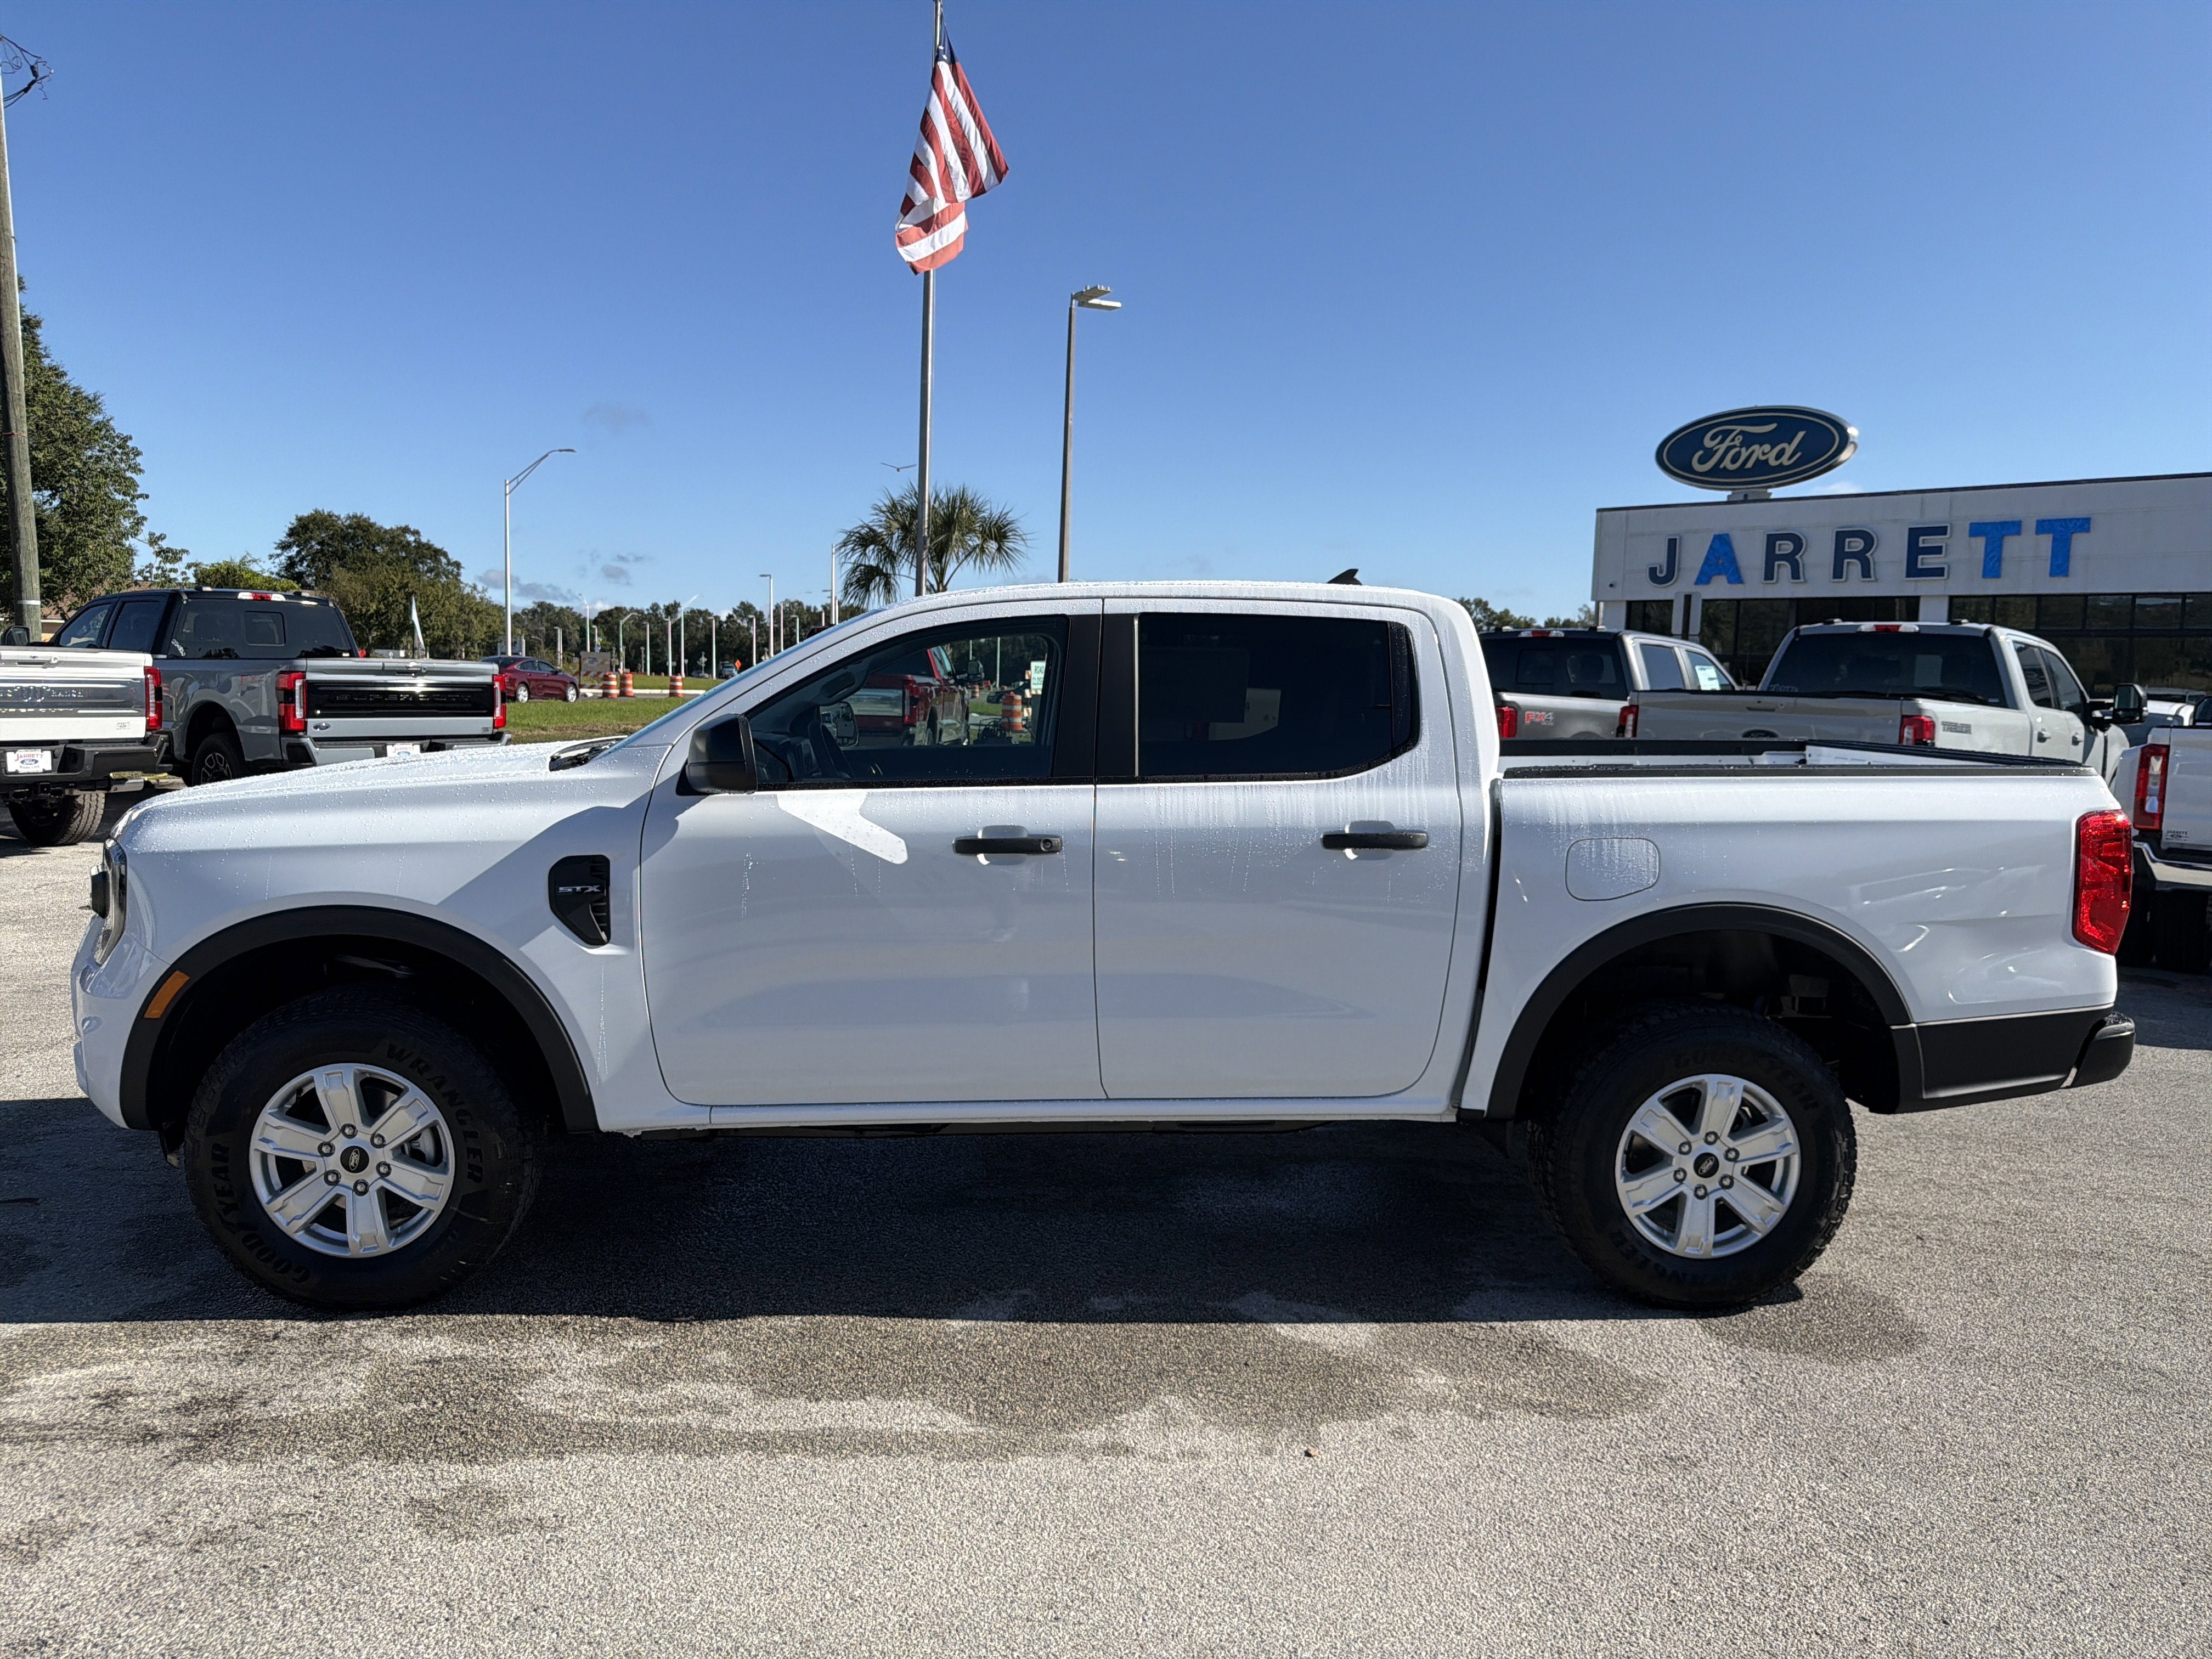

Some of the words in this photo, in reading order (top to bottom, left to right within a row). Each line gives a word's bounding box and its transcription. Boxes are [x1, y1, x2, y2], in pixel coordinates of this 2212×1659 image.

[1691, 422, 1807, 472] Ford
[1646, 517, 2092, 587] JARRETT
[1525, 711, 1554, 724] FX4
[14, 753, 44, 761] JARRETT
[558, 884, 602, 894] STX
[386, 1042, 484, 1185] WRANGLER
[211, 1141, 312, 1284] GOODYEAR
